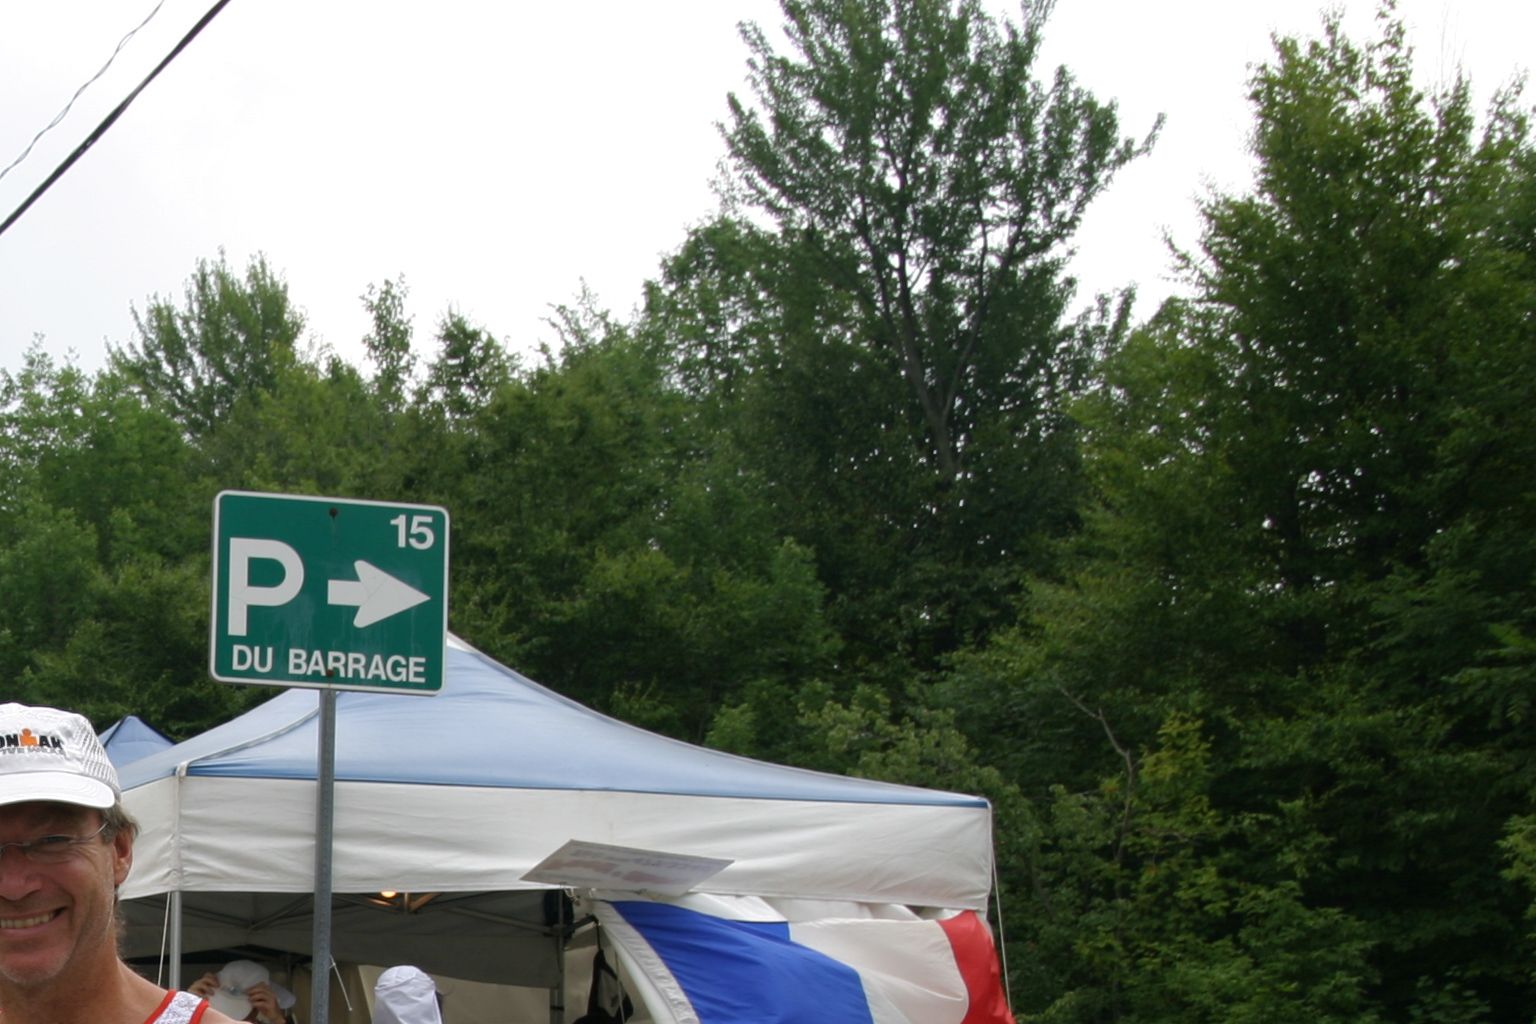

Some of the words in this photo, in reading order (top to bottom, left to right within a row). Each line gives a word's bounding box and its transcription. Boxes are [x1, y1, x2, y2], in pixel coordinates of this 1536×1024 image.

[390, 514, 435, 550] 15
[227, 537, 305, 637] P
[232, 645, 274, 673] DU
[288, 648, 426, 683] BARRAGE
